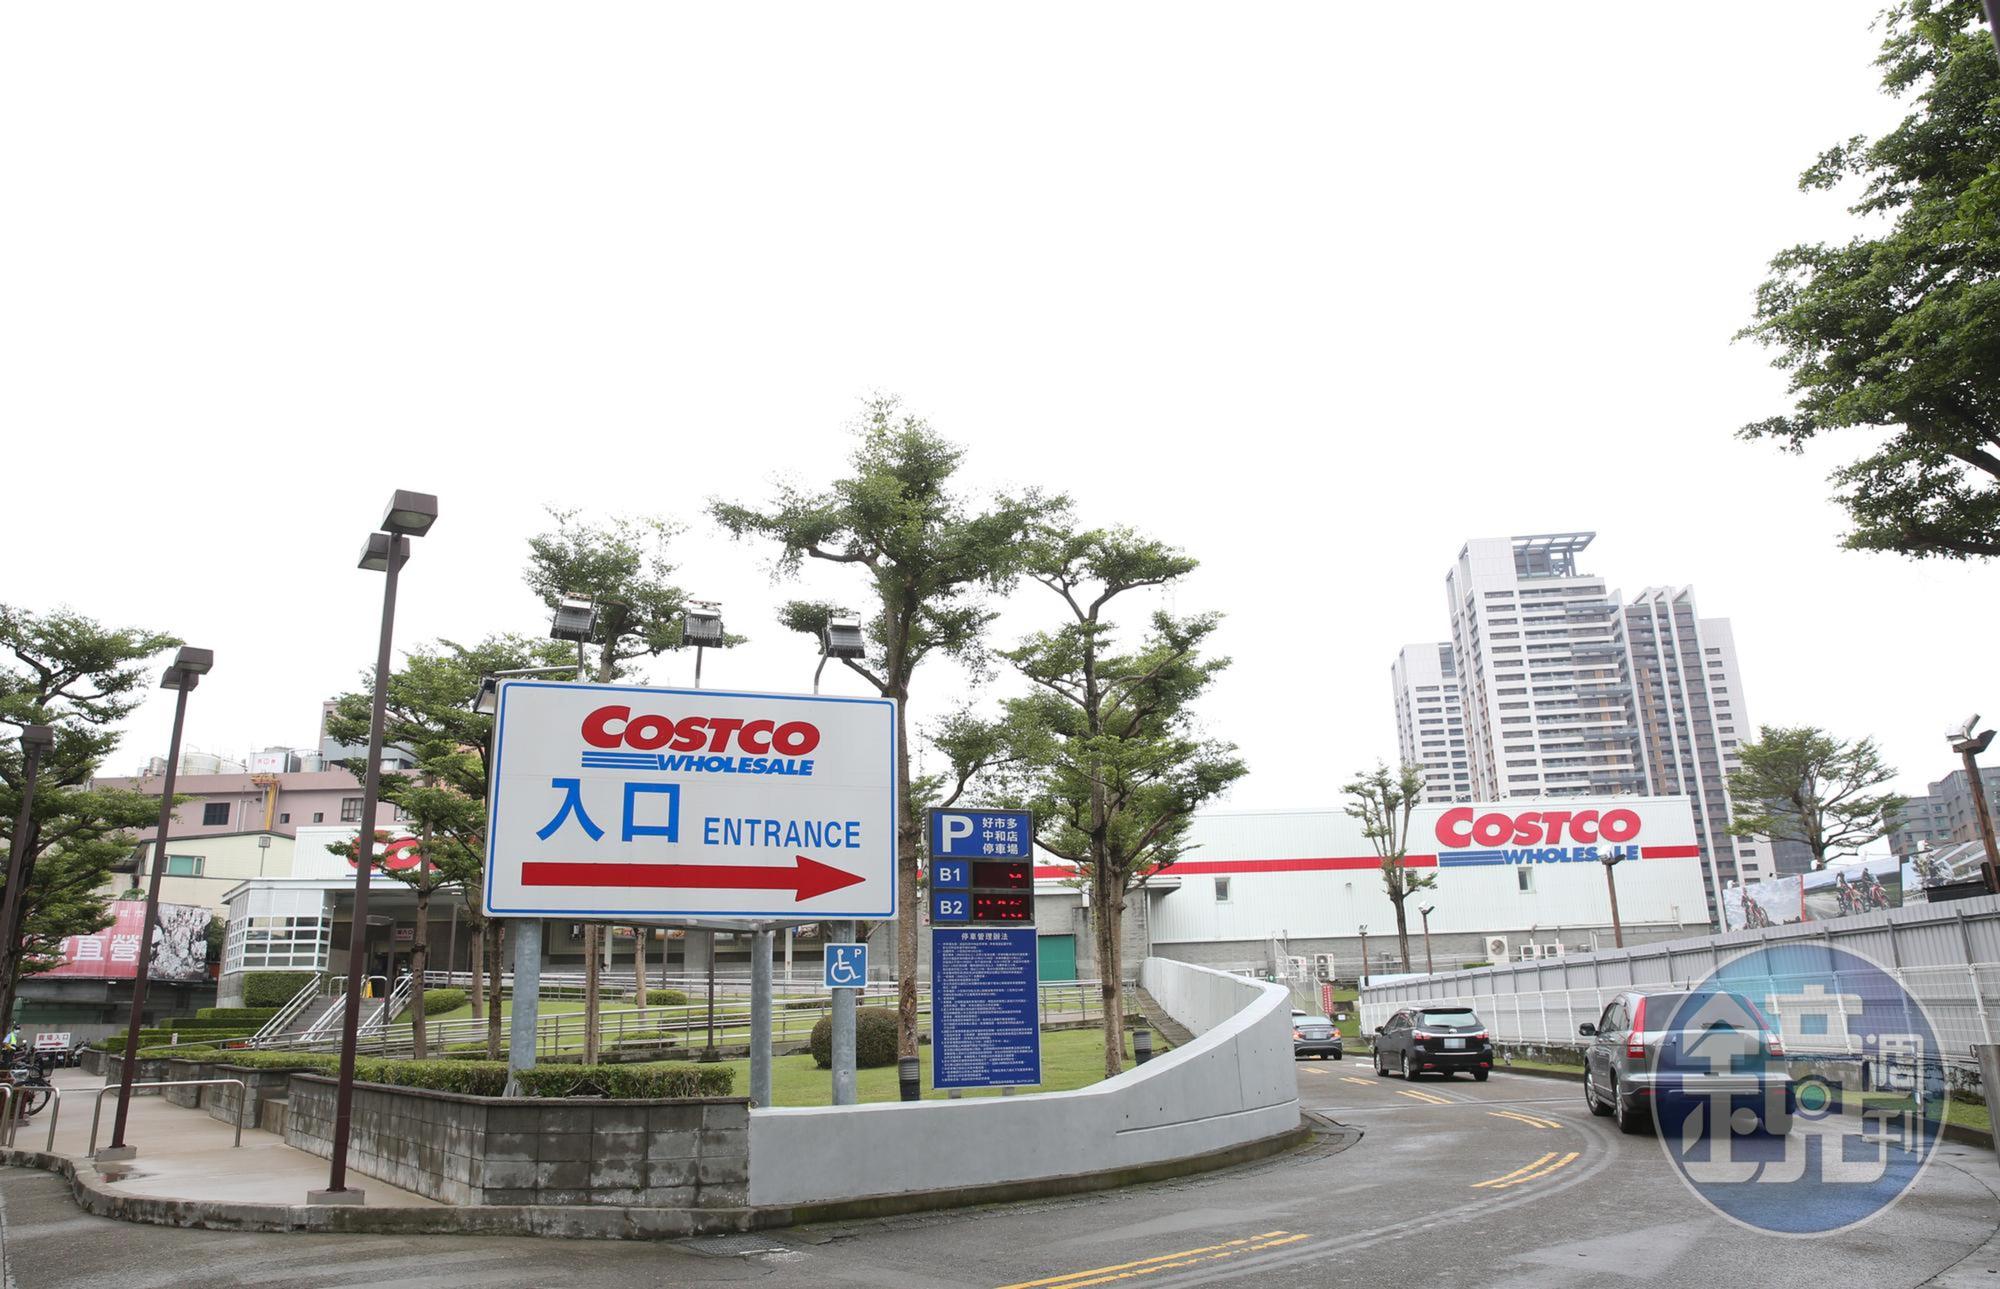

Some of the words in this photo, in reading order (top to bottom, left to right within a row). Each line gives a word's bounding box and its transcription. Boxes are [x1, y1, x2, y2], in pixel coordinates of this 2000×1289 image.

[581, 705, 820, 756] COSTCO
[656, 754, 815, 776] WHOLESALE
[536, 778, 681, 844] 入口
[703, 817, 861, 849] ENTRANCE
[982, 817, 1017, 828] 好市多
[1435, 807, 1641, 848] COSTCO
[942, 815, 973, 852] P
[982, 831, 1018, 842] 中和店
[982, 843, 1018, 854] 停車場
[1503, 845, 1639, 864] WHOLESLE
[940, 868, 960, 881] B1
[940, 901, 963, 915] B2
[854, 948, 862, 958] P
